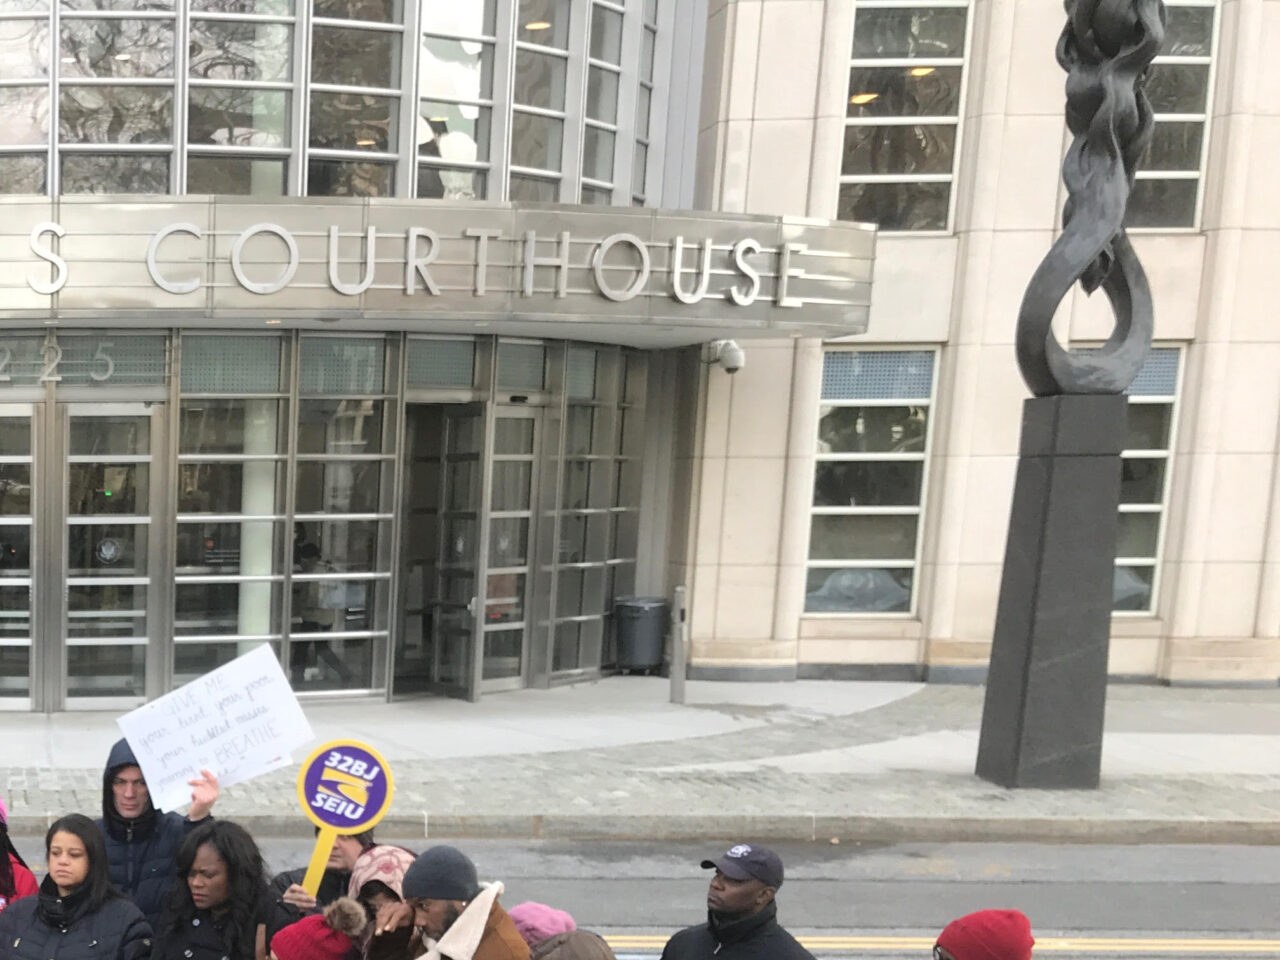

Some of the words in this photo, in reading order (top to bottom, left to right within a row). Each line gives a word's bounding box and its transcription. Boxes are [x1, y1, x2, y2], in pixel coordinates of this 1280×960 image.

[146, 221, 809, 309] COURTHOUSE
[324, 750, 380, 781] 32BJ
[311, 792, 365, 820] SEIU
